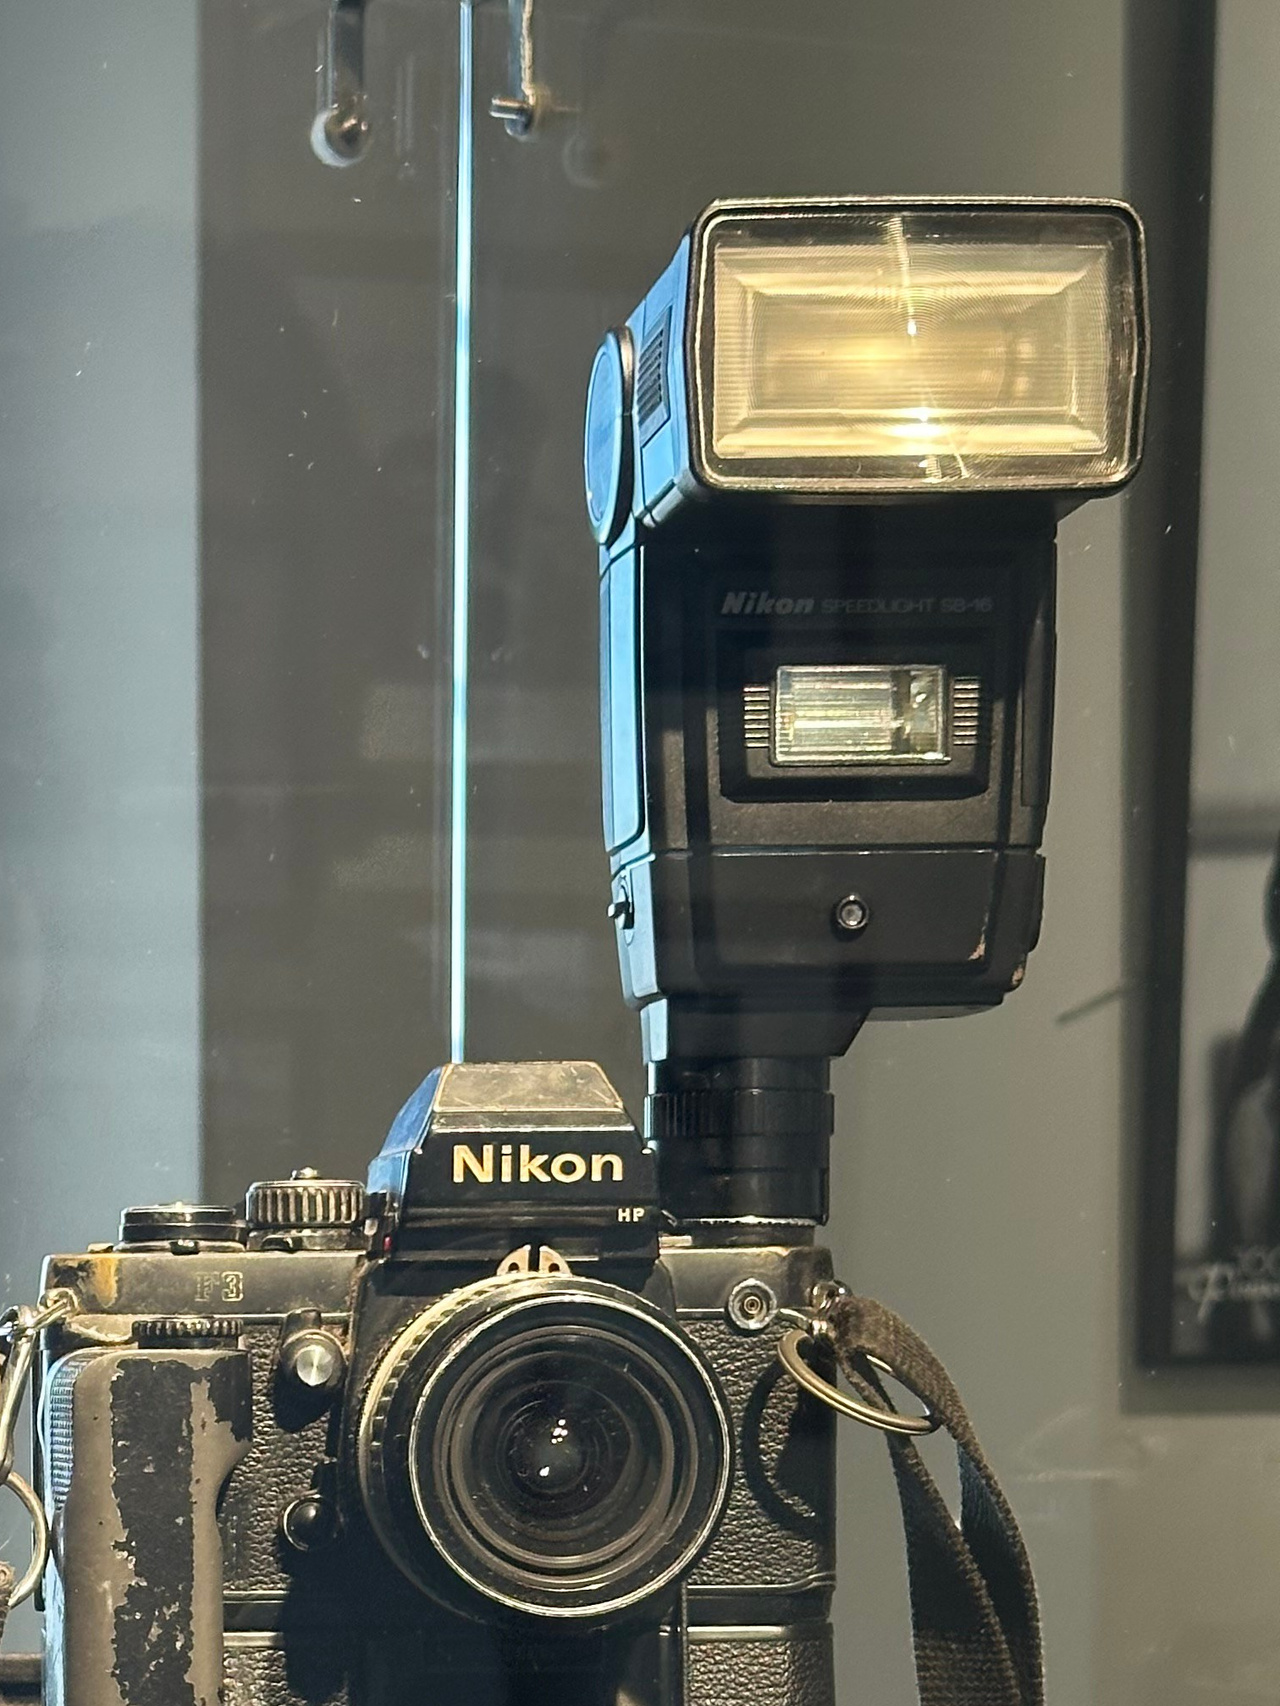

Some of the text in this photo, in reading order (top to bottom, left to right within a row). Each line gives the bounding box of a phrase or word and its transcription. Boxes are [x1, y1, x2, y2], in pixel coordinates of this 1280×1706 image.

[721, 591, 816, 615] Nikon
[452, 1144, 624, 1183] Nikon
[617, 1207, 645, 1222] HP
[194, 1271, 244, 1302] F3
